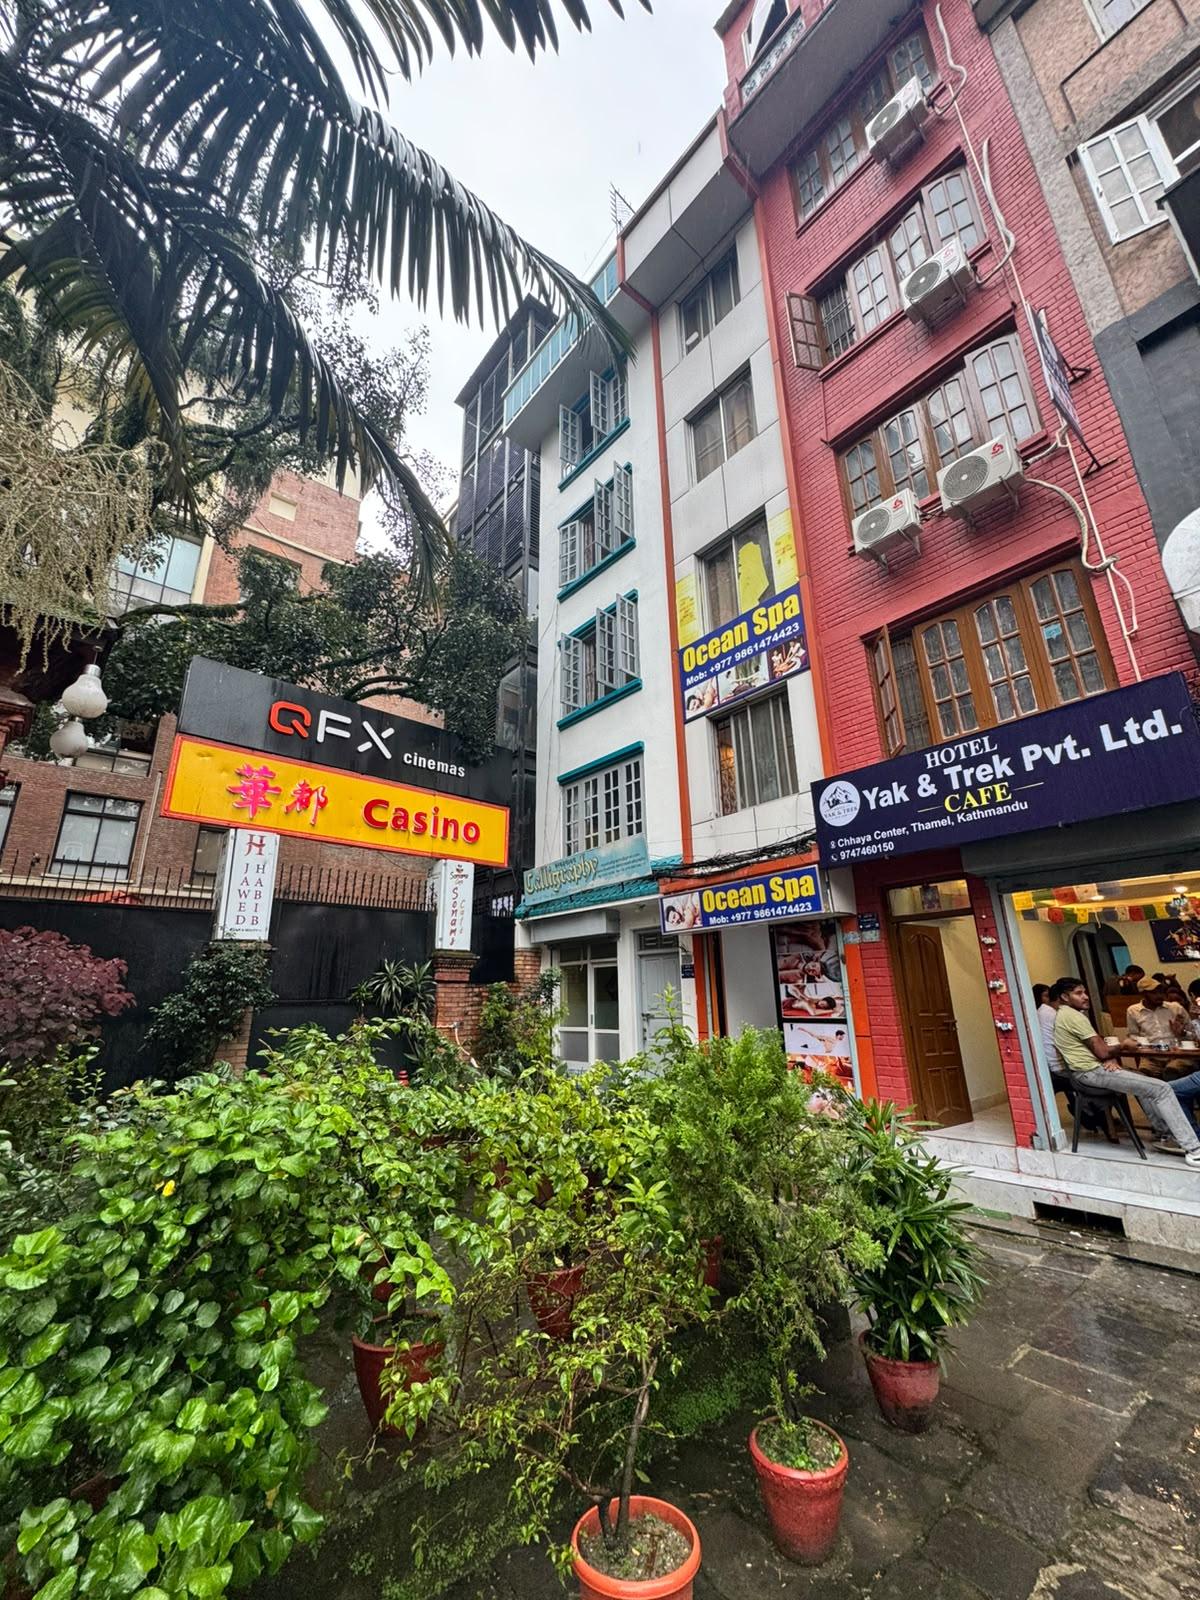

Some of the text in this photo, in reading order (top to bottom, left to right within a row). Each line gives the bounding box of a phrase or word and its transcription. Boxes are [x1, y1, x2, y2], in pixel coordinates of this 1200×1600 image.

[683, 594, 801, 673] Ocean Spa
[686, 622, 800, 686] Mob: +977 9861474423
[269, 700, 466, 778] QFX cinemas
[862, 709, 1183, 810] Yak & Trek Pvt. Ltd.
[924, 736, 998, 769] HOTEL
[944, 782, 1012, 813] CAFE
[362, 799, 481, 844] Casino
[837, 800, 1028, 849] Chhaya Center, Thamel, Kathmandu
[840, 842, 894, 860] 9747460150
[236, 863, 250, 925] JAWED
[251, 863, 266, 926] HABIB
[525, 855, 599, 895] Calligraphy
[702, 874, 816, 913] Ocean Spa
[709, 902, 812, 925] Mob: +977 9861474423
